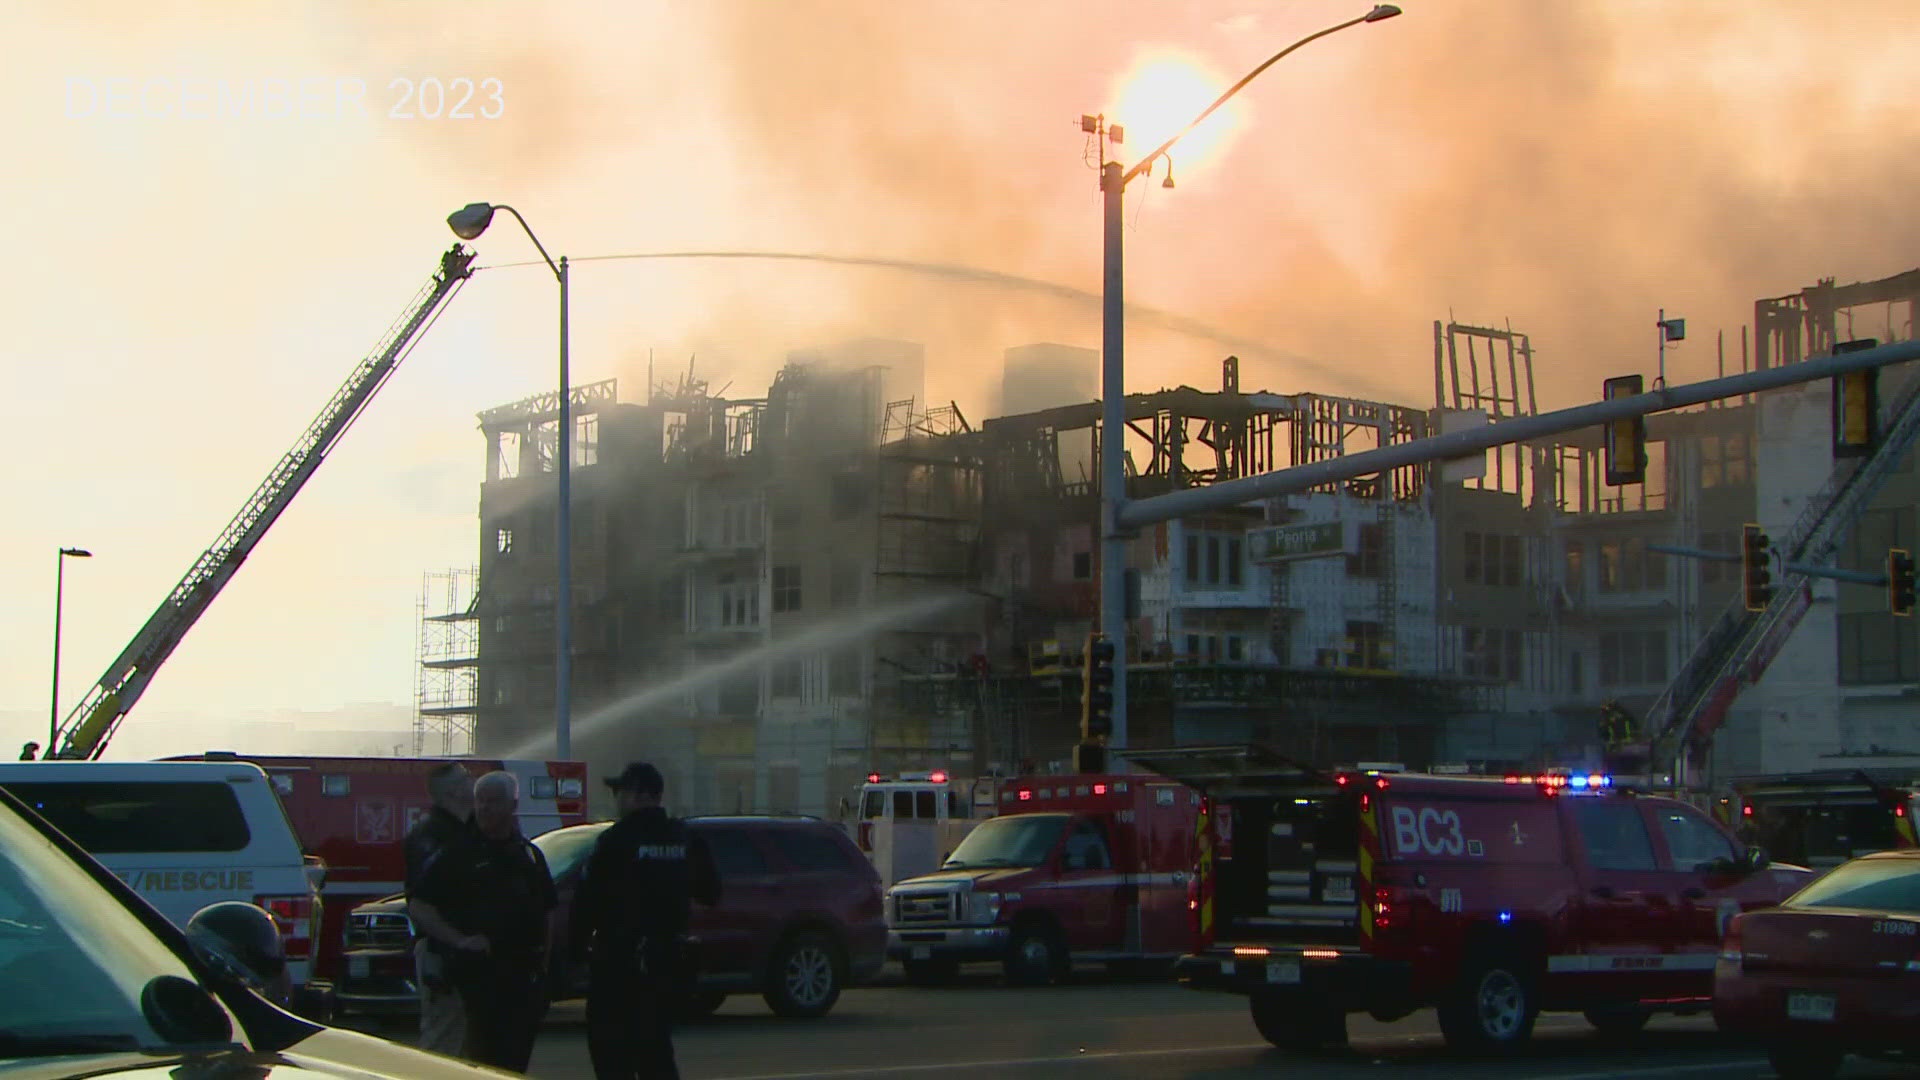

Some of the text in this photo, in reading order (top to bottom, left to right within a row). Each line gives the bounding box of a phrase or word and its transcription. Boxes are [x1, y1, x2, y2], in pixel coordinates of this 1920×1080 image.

[1275, 526, 1318, 548] Peoria
[1391, 806, 1465, 856] BC3
[638, 844, 687, 860] POLICE
